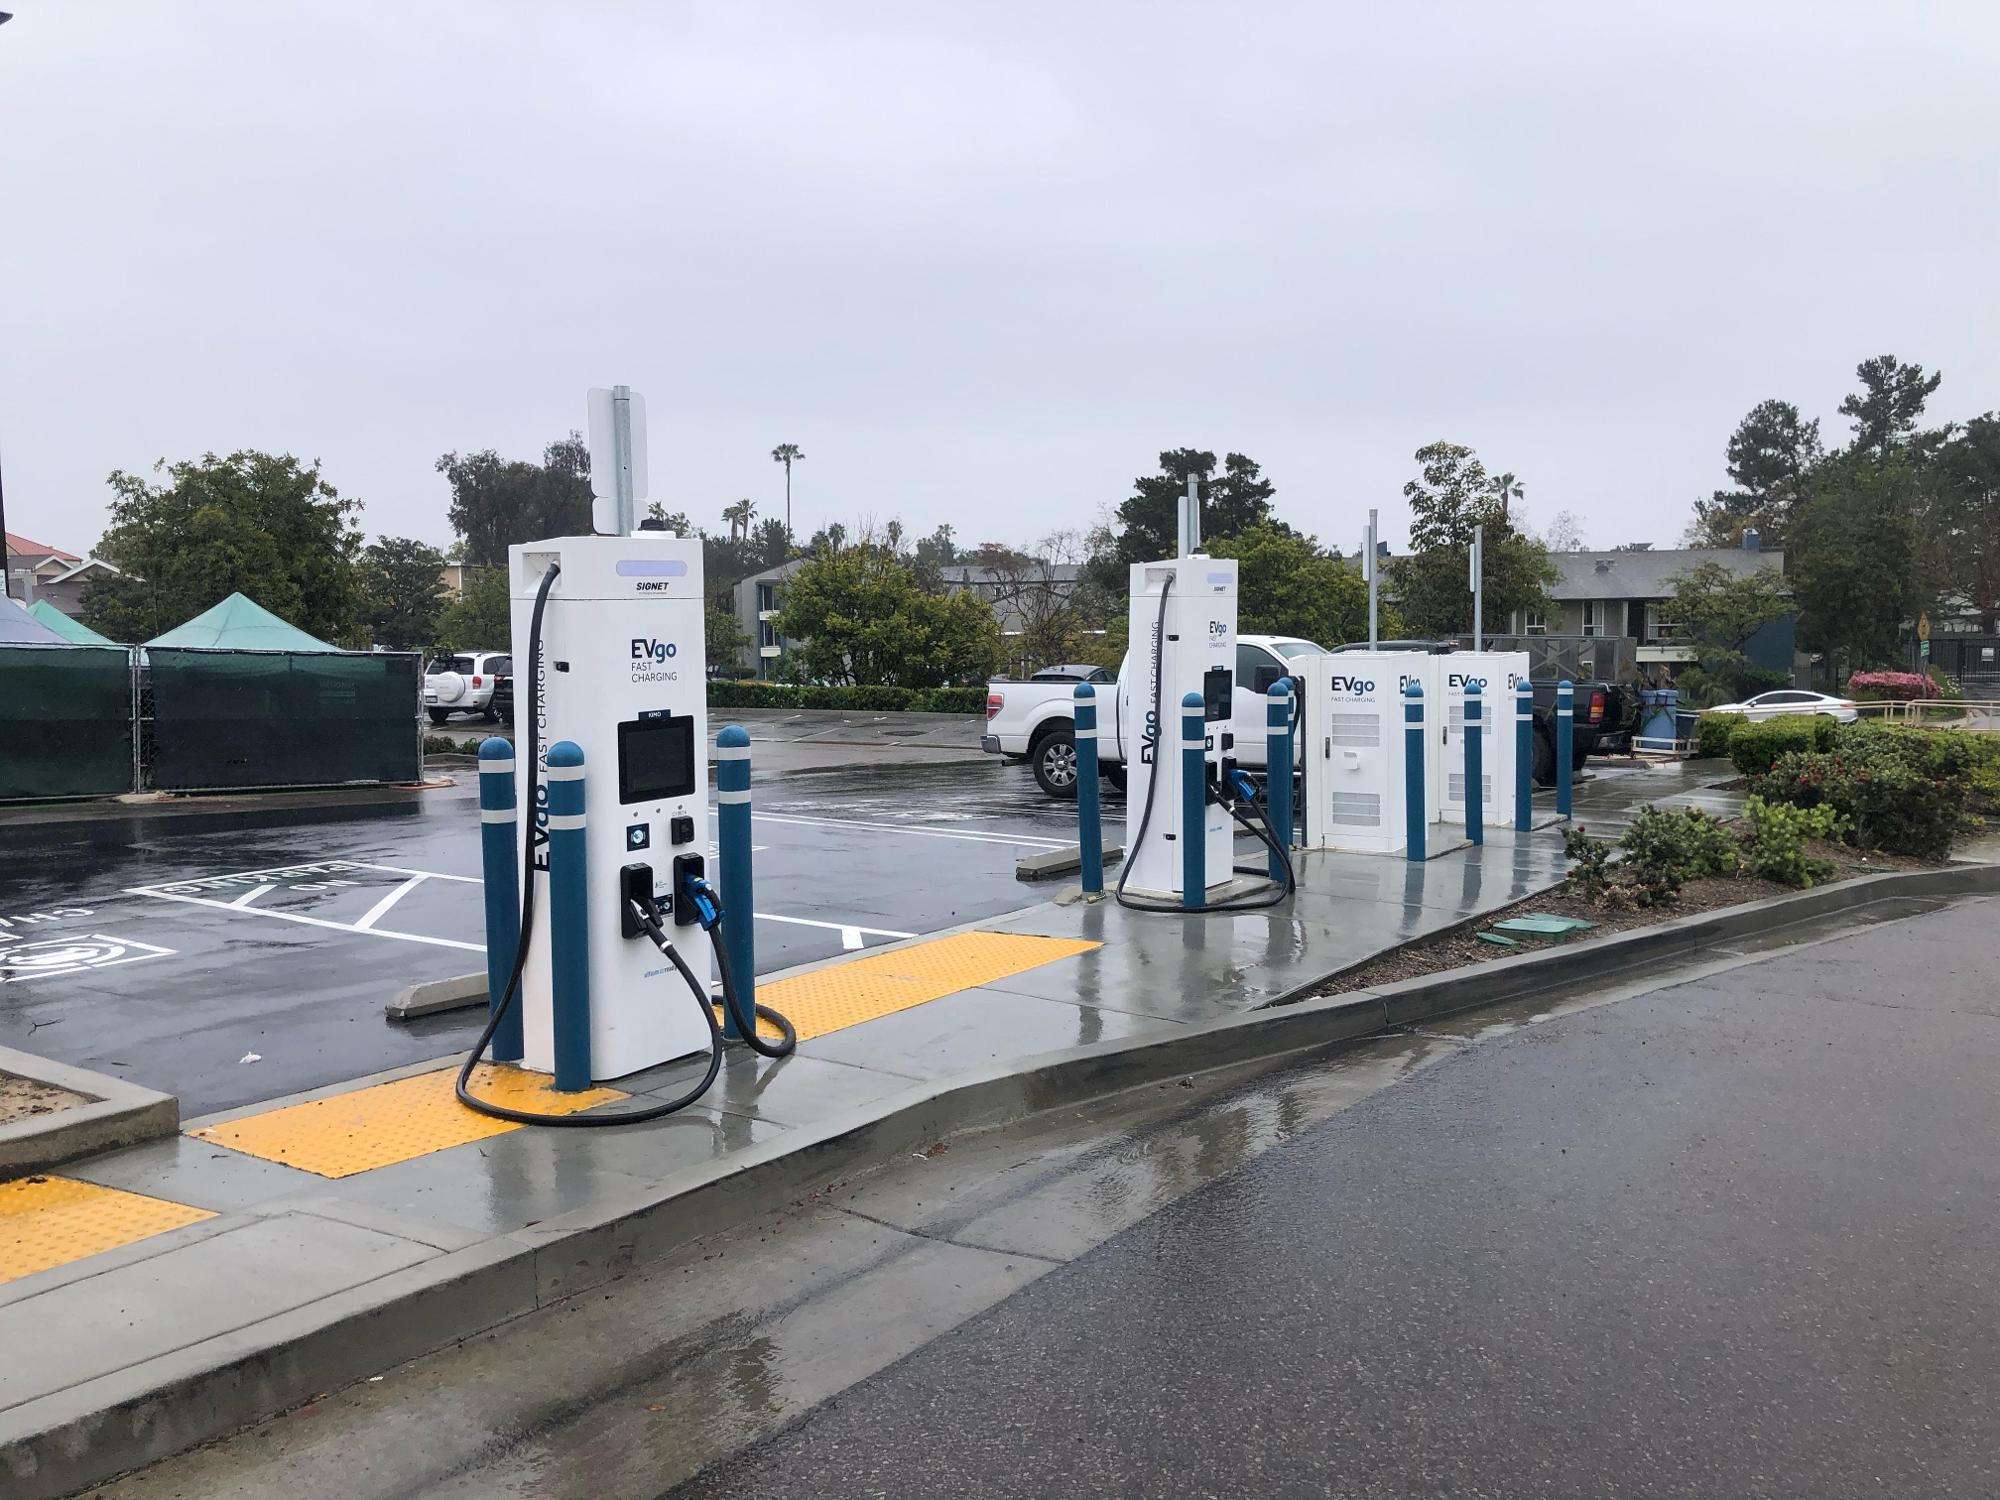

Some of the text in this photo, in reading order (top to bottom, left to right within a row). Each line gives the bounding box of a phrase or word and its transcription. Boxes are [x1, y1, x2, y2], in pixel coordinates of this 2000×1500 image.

[636, 582, 669, 591] SIGNET
[1209, 620, 1227, 637] EVgo
[631, 638, 677, 664] EVgo
[631, 661, 652, 672] FAST
[631, 671, 678, 683] CHARGING
[1331, 676, 1376, 696] EVgo
[538, 733, 548, 773] FAST
[163, 864, 357, 893] PARKING
[288, 879, 361, 891] NO
